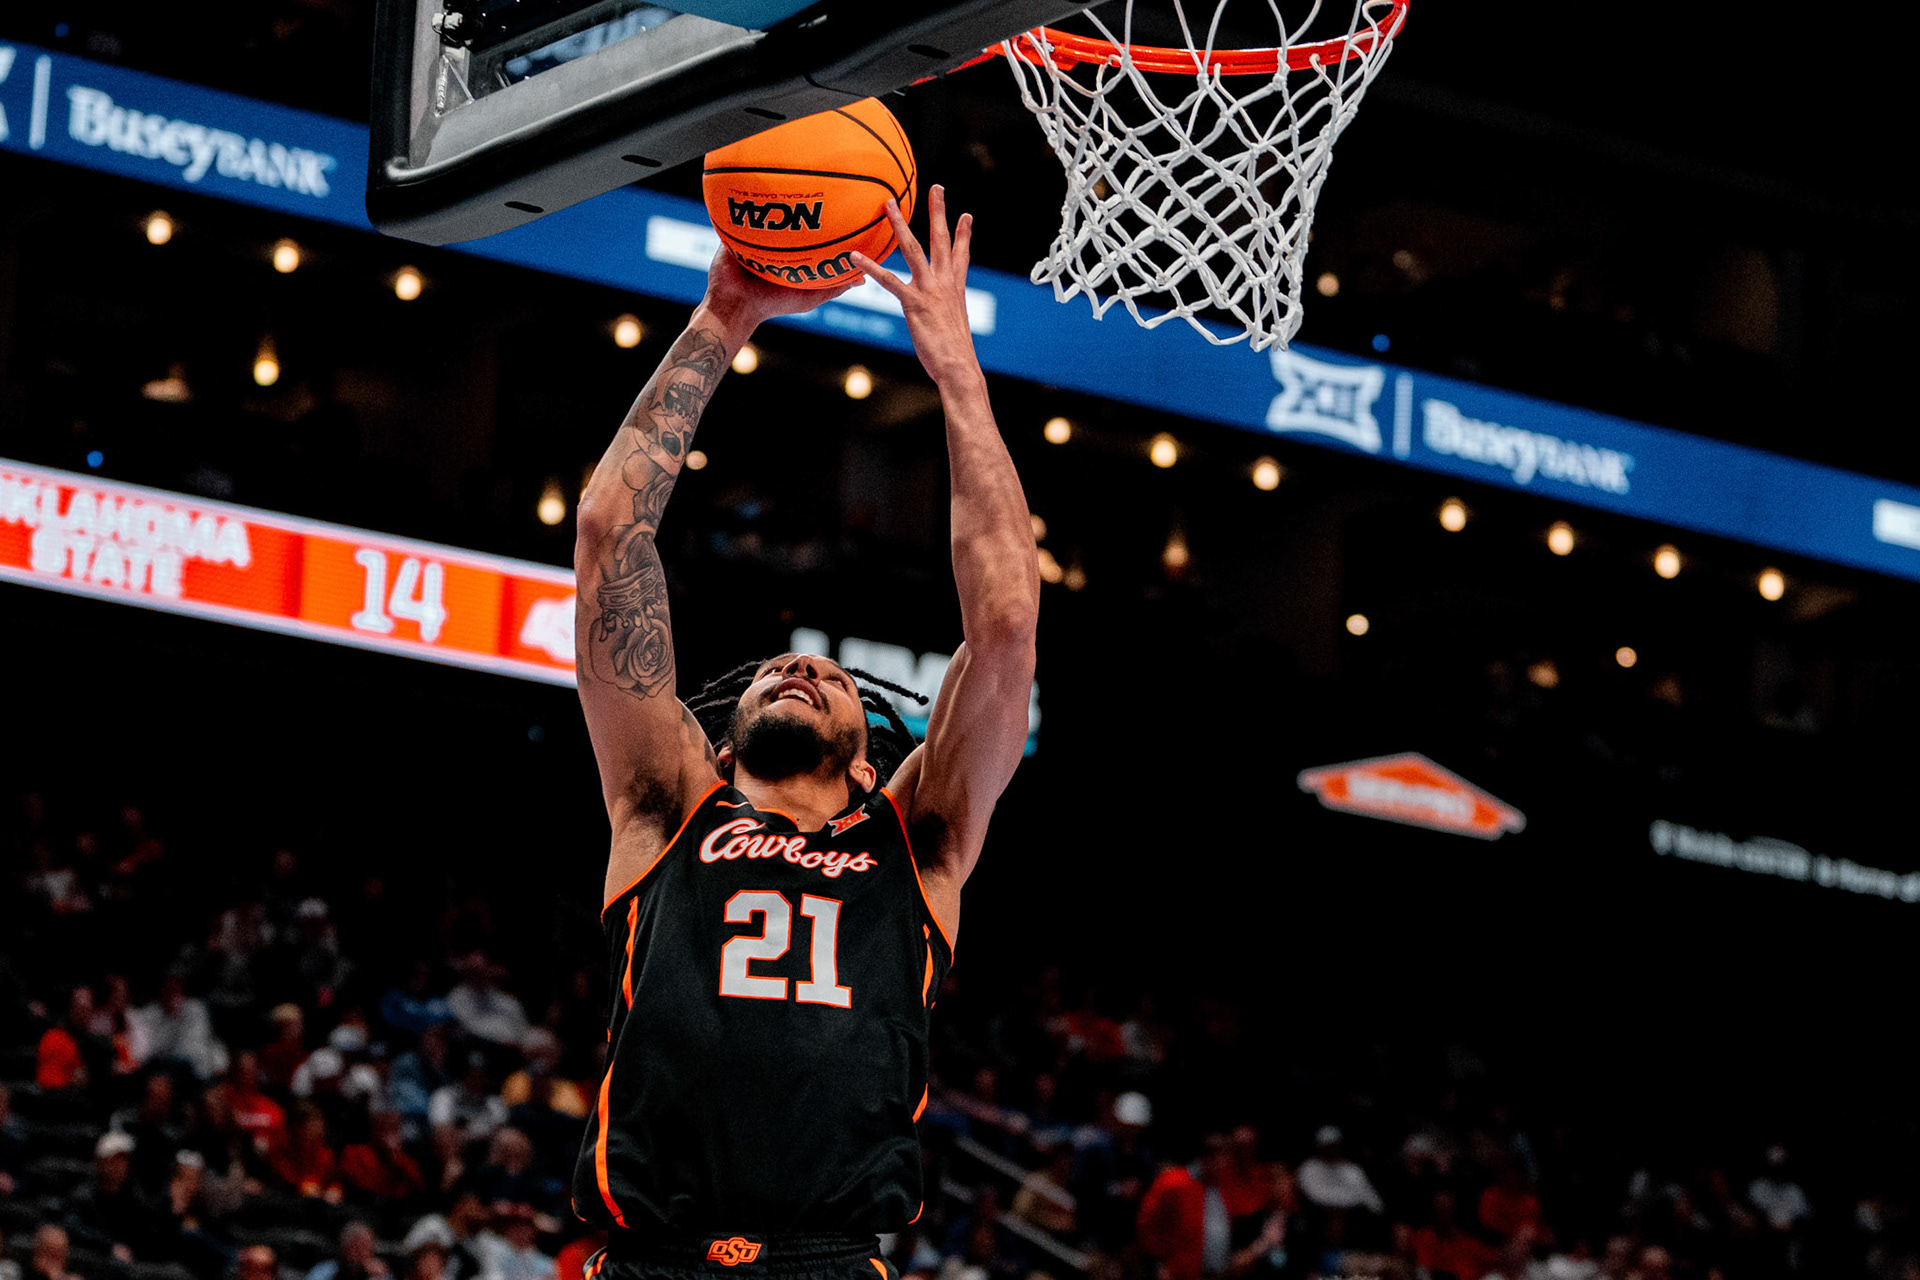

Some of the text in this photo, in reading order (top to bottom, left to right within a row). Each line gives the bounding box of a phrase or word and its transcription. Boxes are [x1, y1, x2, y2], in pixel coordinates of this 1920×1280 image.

[728, 187, 824, 199] OFFICIAL GAME BALL
[728, 197, 824, 232] NCAA
[0, 478, 250, 568] KLAHOMA
[31, 528, 182, 599] STATE
[350, 547, 447, 643] 14
[699, 817, 878, 879] Cowboys
[719, 889, 852, 1009] 21
[708, 1237, 761, 1266] OSU
